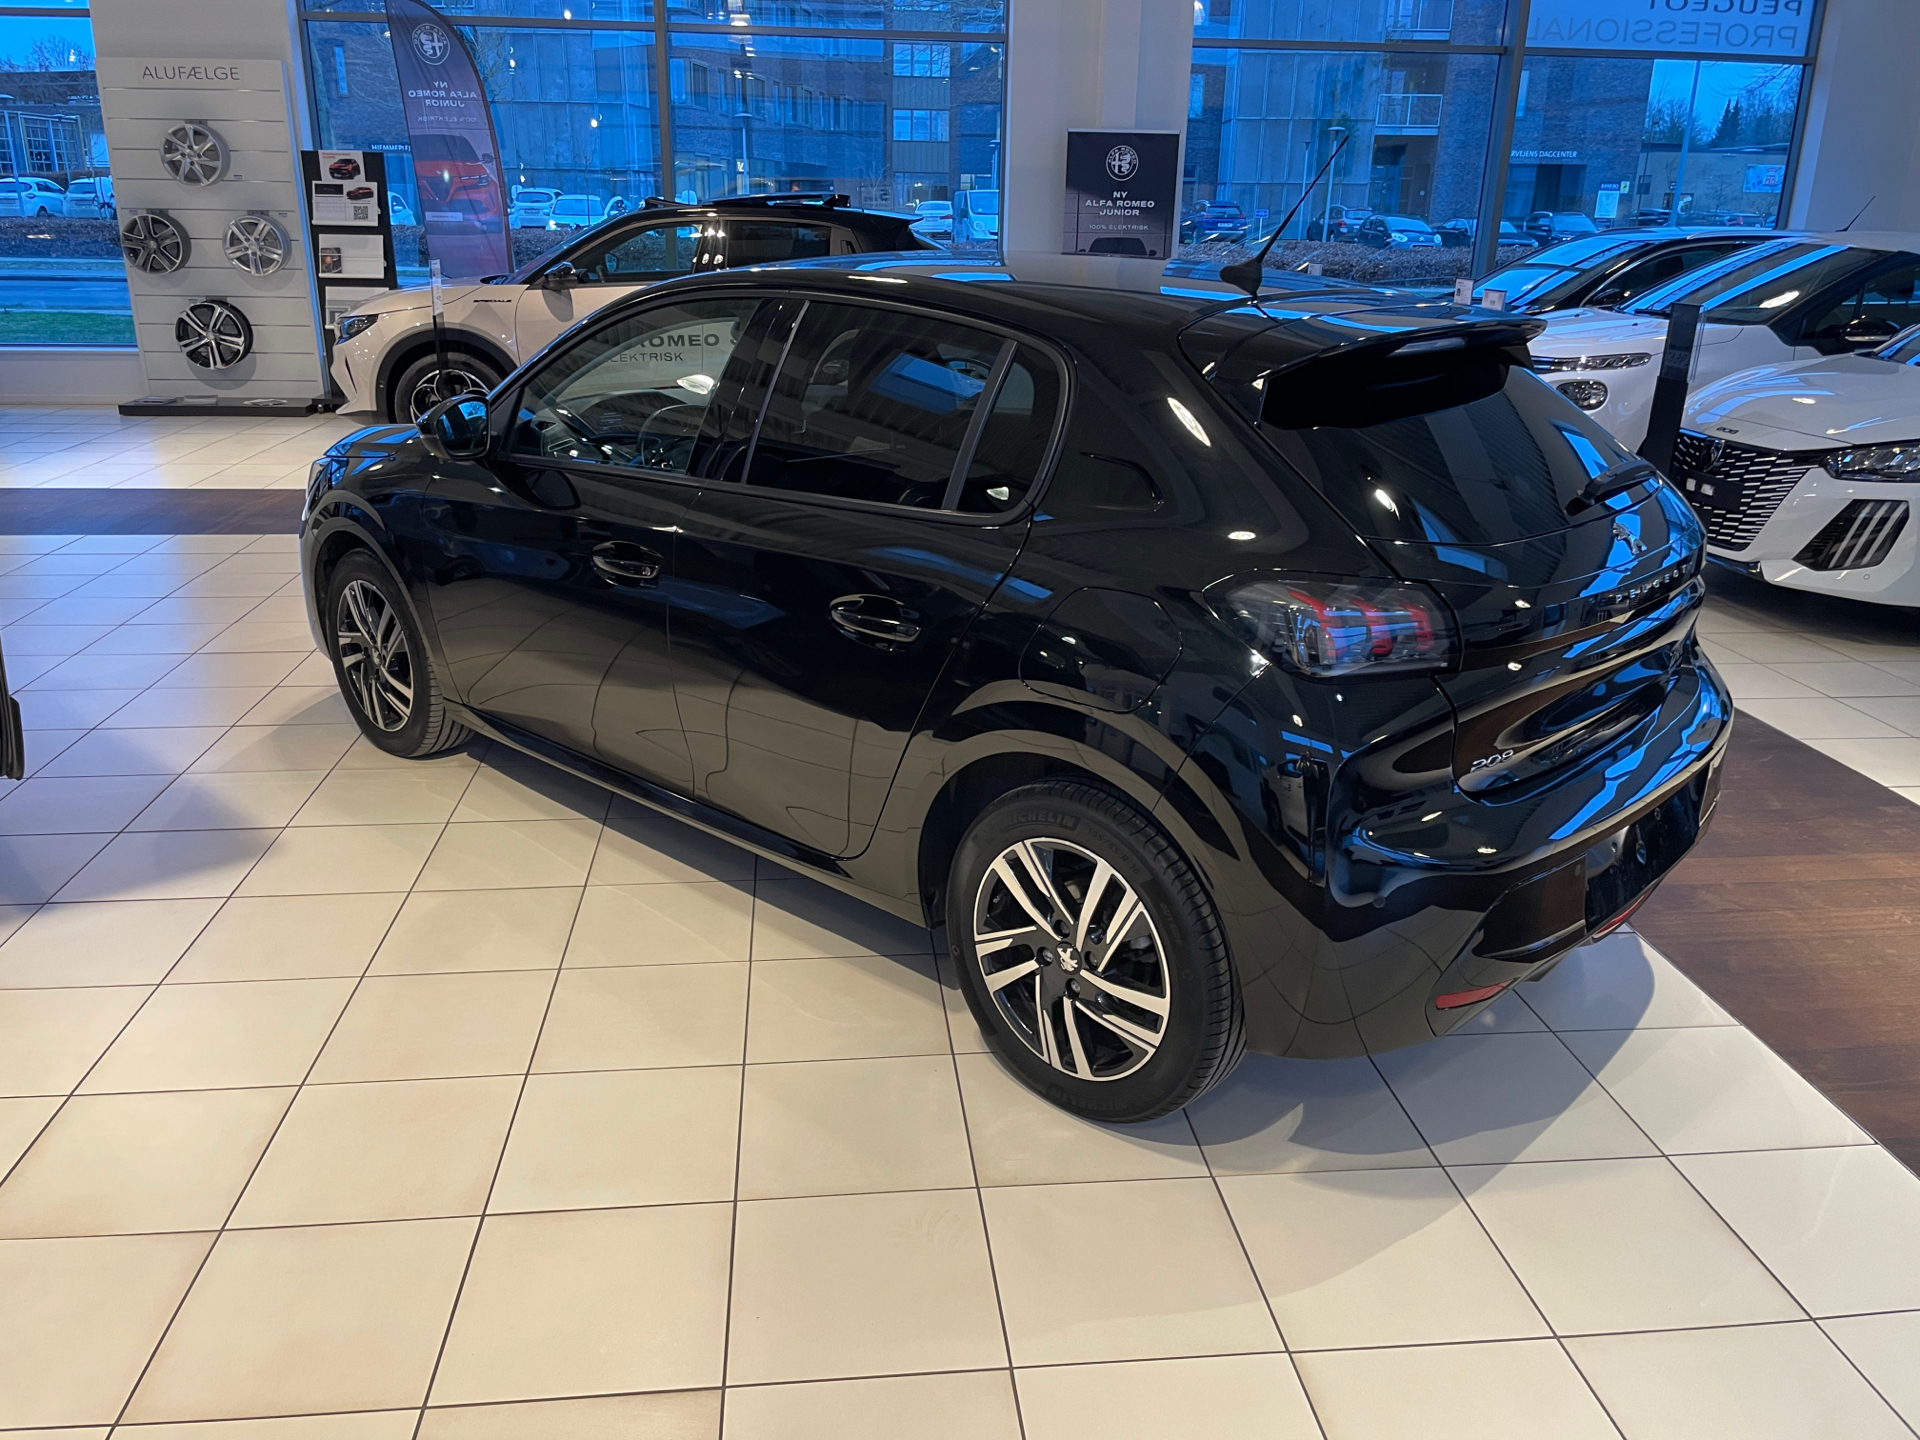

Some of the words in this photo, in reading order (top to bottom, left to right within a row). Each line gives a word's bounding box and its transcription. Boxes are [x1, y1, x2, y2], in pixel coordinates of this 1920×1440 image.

[142, 65, 241, 81] ALUFÆLGE
[1539, 150, 1578, 158] DAGCENTER
[1113, 191, 1128, 199] NY
[1116, 200, 1155, 208] ROMEO
[604, 352, 683, 363] LEKTRISK
[1615, 563, 1689, 604] PEUGEOT
[1470, 749, 1514, 774] 208
